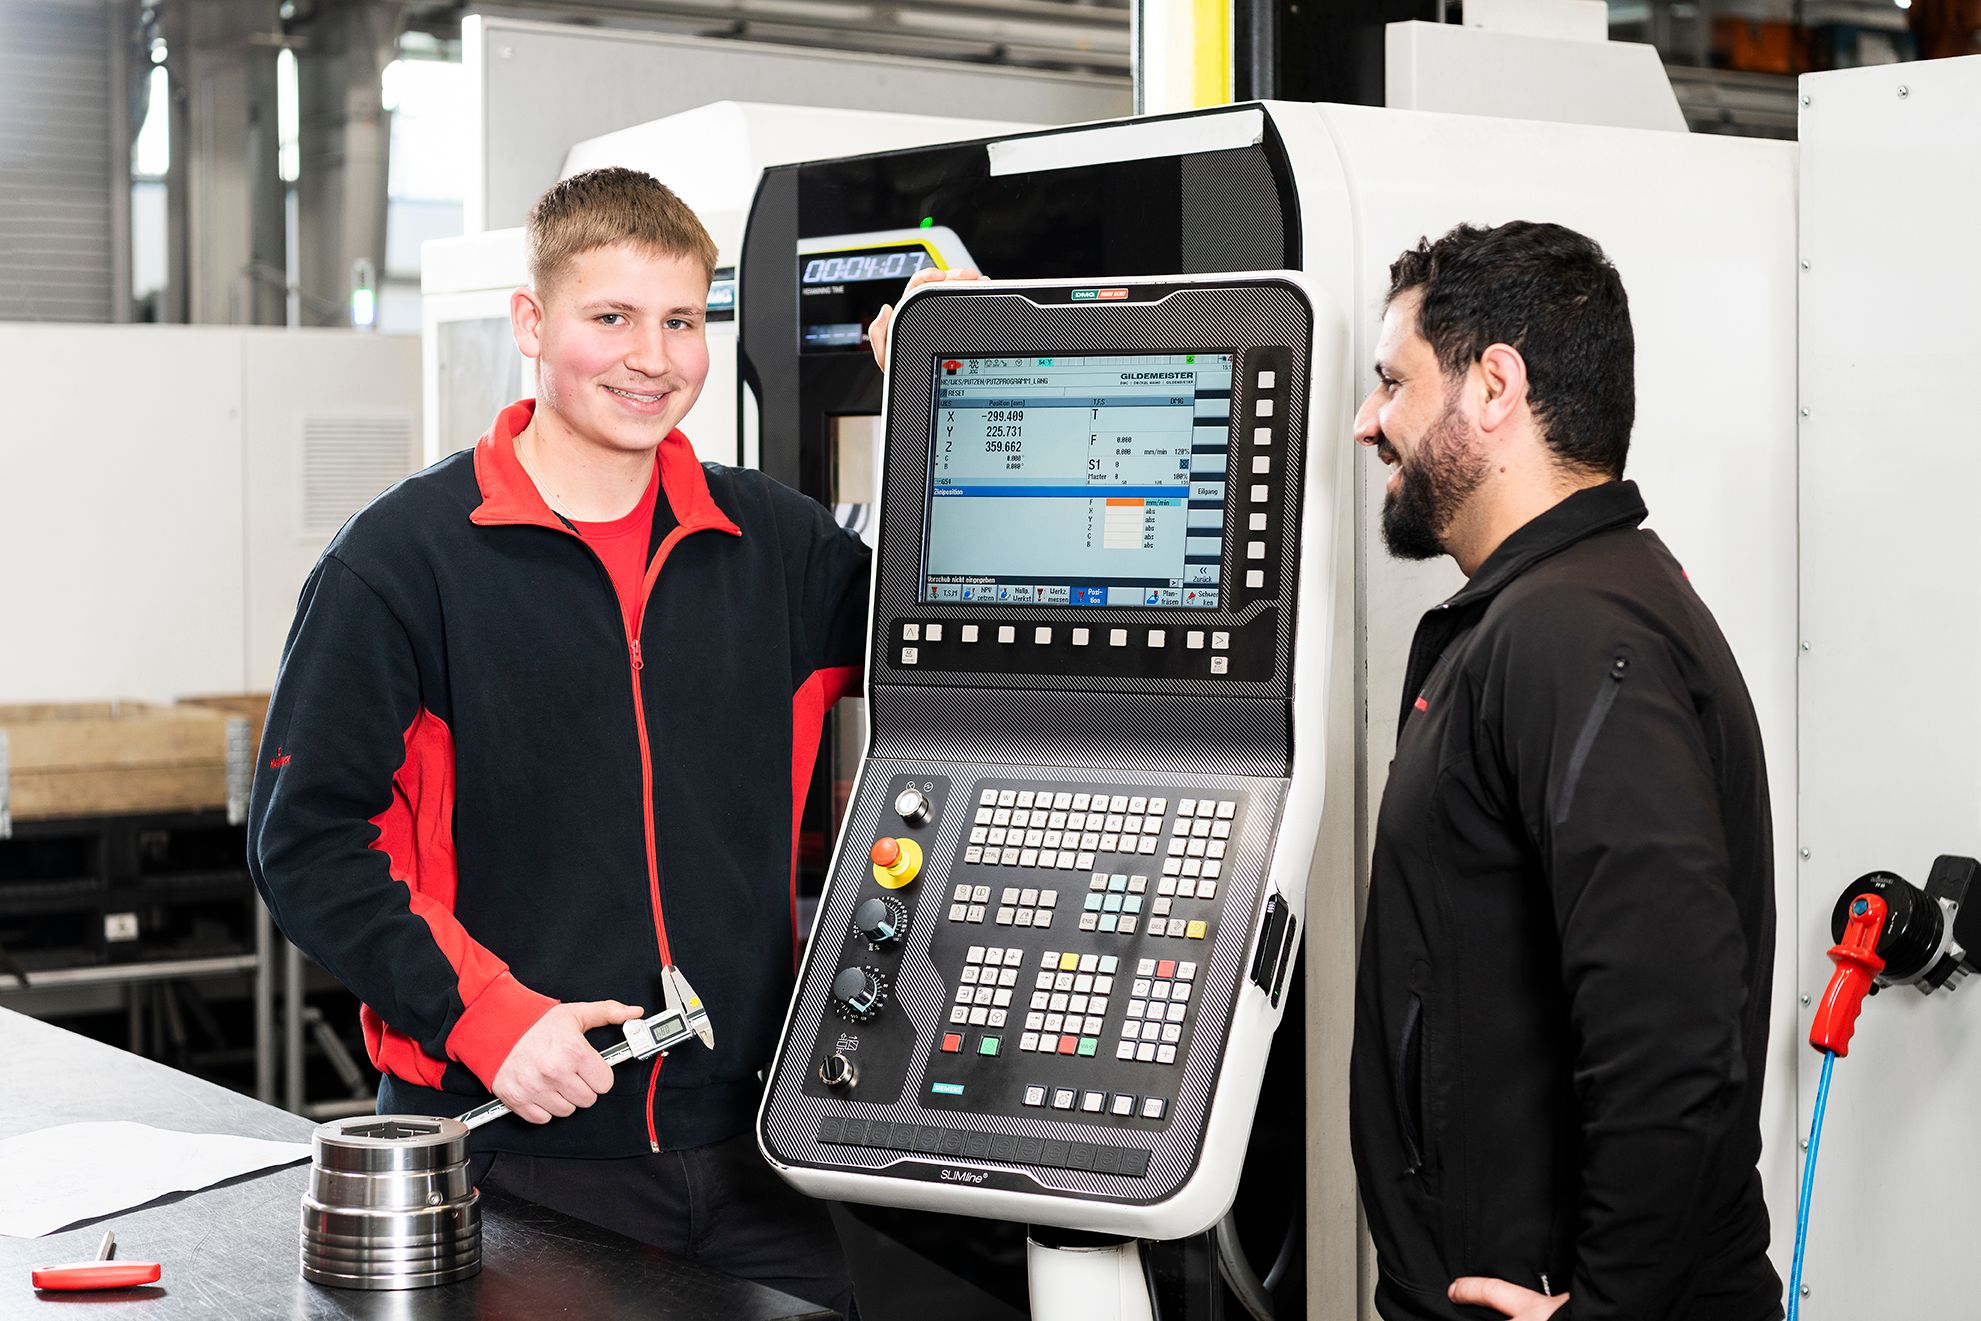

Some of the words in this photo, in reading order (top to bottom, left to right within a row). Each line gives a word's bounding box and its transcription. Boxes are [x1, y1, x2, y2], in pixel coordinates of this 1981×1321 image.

[803, 252, 928, 282] 00:04:07
[947, 411, 955, 422] X
[982, 410, 1024, 421] -299.409
[1092, 409, 1098, 420] T
[947, 426, 953, 437] Y
[986, 426, 1022, 437] 225.731
[1091, 435, 1097, 445] F
[945, 442, 952, 452] Z
[985, 441, 1022, 452] 359.662
[1088, 459, 1100, 470] S1
